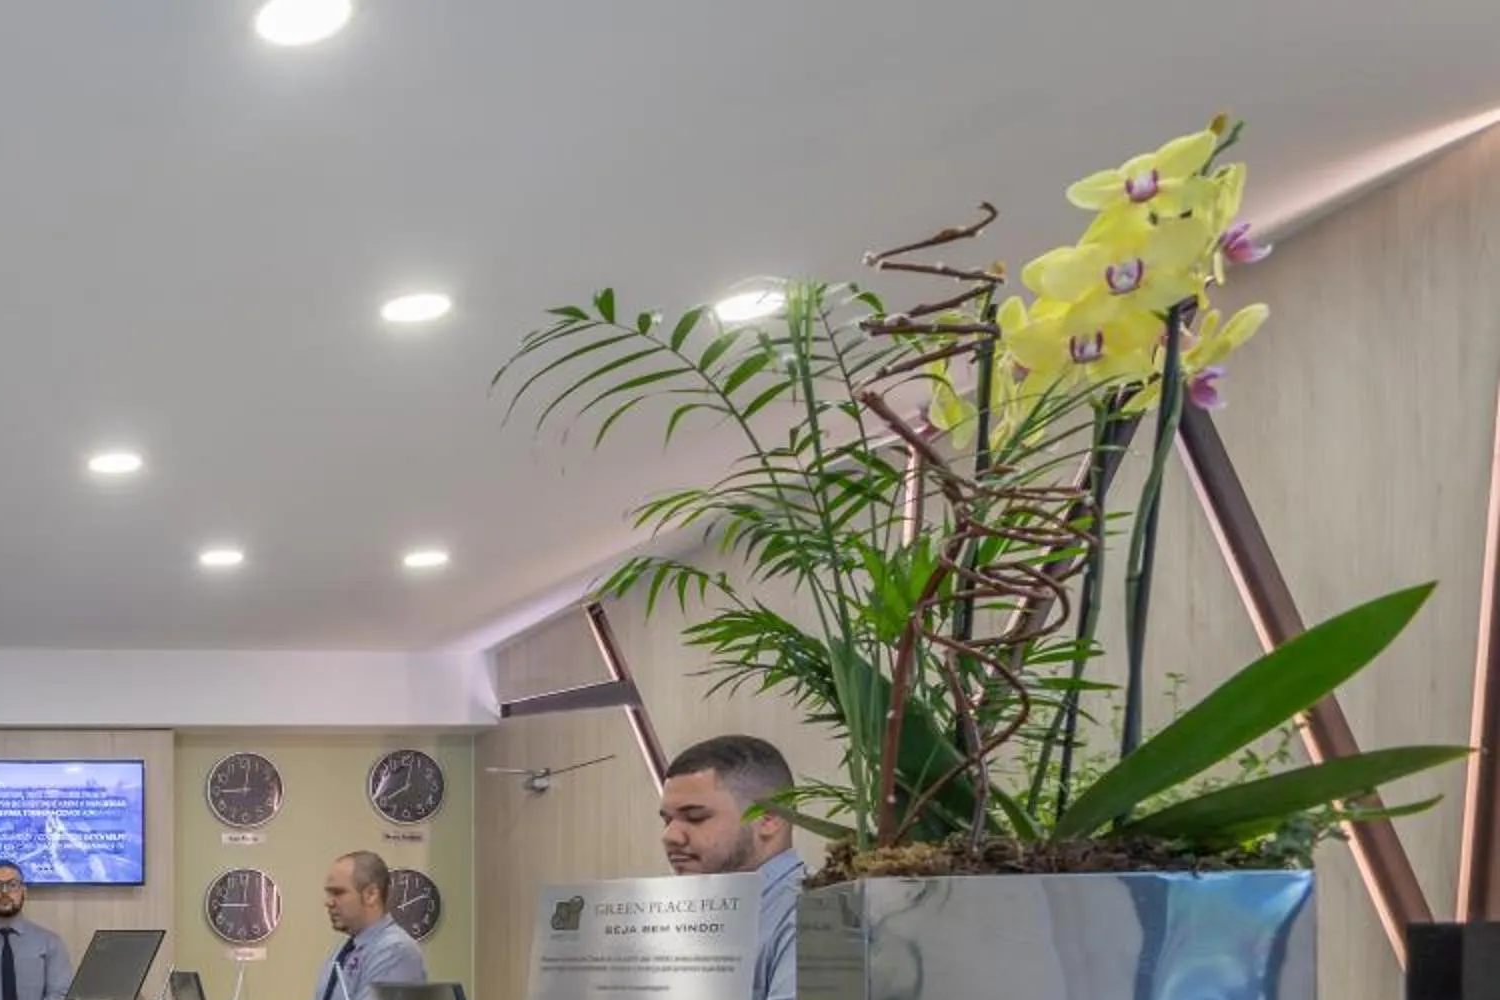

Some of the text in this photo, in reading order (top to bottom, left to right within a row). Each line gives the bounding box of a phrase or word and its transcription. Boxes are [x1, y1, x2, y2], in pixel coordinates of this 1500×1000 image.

[595, 897, 741, 916] GREEN PLACE FLAT
[604, 925, 637, 935] SEJA
